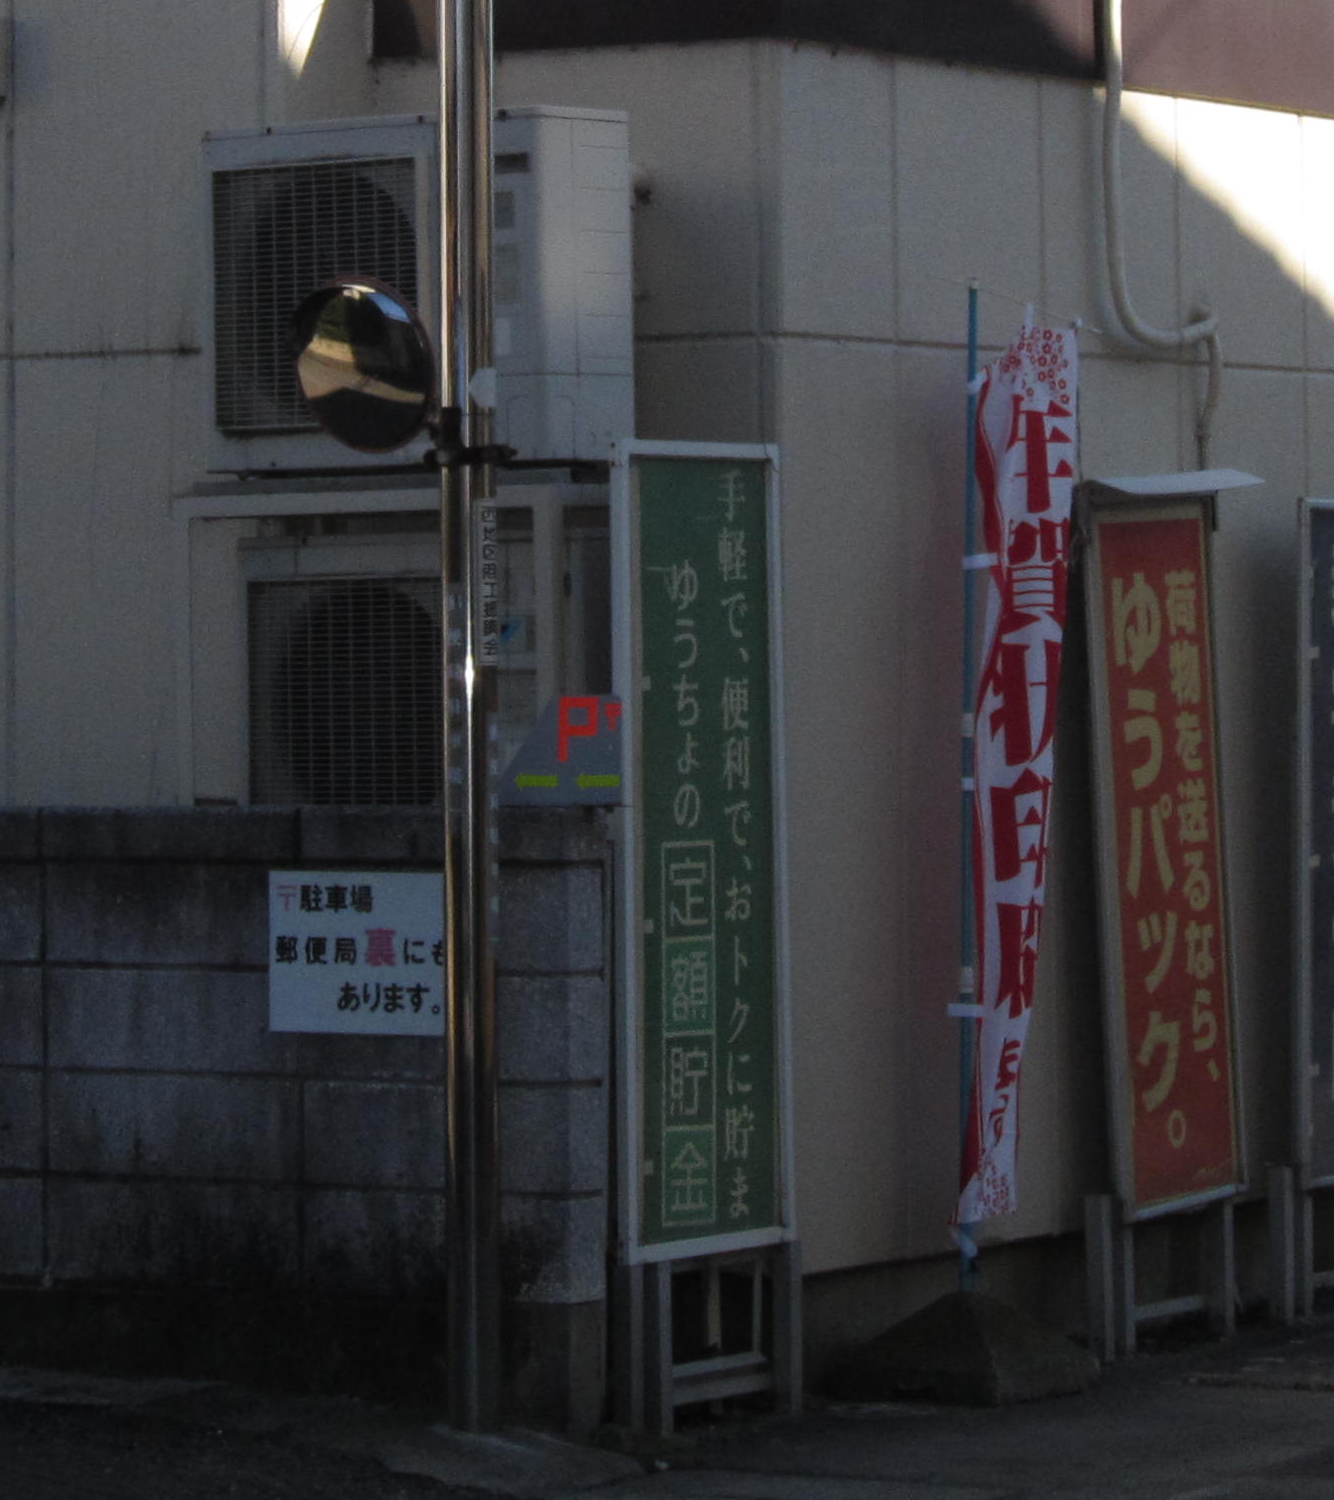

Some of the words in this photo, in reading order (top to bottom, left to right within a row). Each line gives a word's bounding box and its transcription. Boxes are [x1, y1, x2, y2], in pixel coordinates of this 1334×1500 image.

[336, 981, 441, 1015] あります。
[1110, 569, 1188, 1149] ゆうパック。
[1164, 567, 1222, 1082] 荷物を送るなら、
